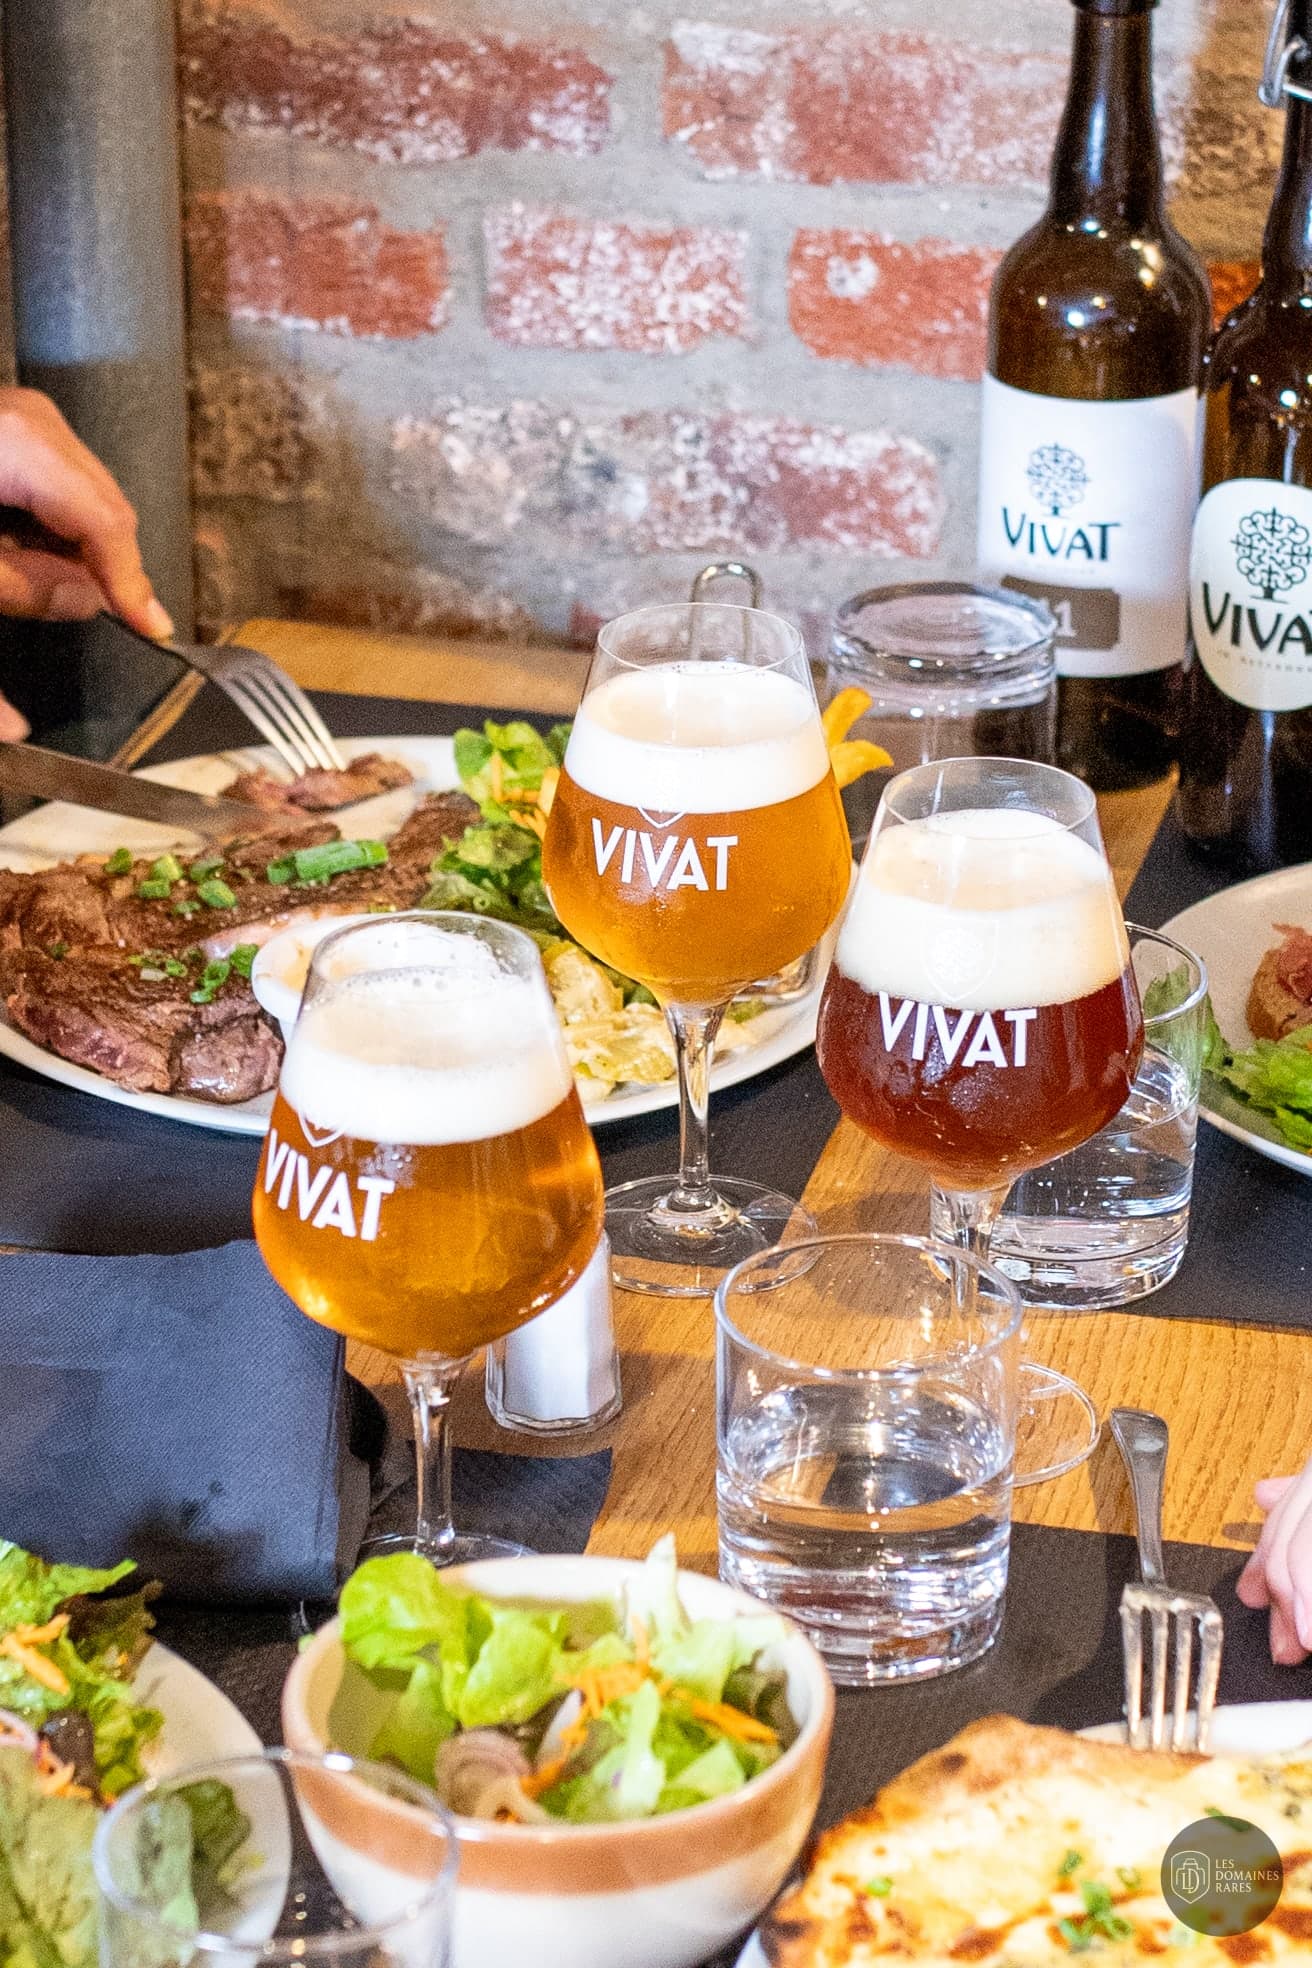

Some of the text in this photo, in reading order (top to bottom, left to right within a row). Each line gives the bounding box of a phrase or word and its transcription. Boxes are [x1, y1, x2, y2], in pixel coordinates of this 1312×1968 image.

[1002, 506, 1121, 561] VIVAT
[1203, 582, 1312, 655] VIVA
[591, 817, 738, 890] VIVAT
[879, 991, 1037, 1067] VIVAT
[265, 1128, 395, 1241] VIVAT
